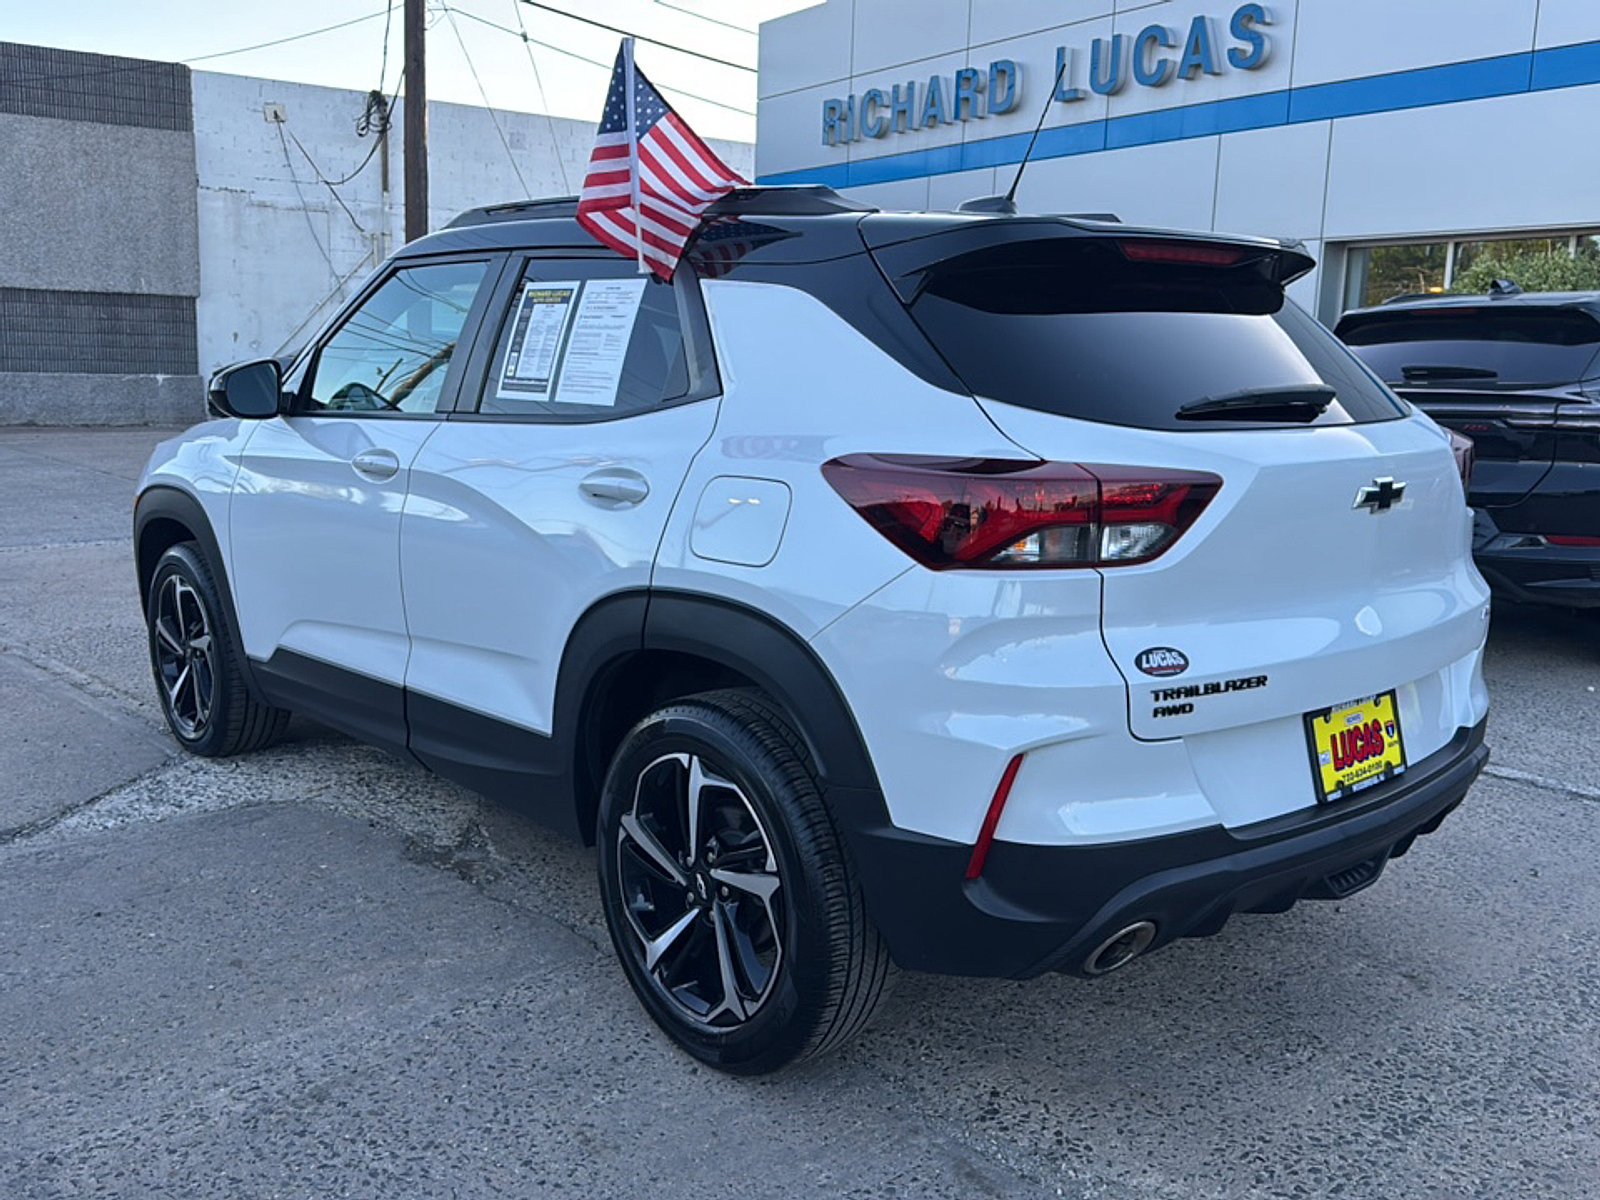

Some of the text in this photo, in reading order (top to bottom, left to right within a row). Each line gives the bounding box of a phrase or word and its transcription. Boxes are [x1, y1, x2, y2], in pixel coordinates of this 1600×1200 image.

[822, 2, 1274, 148] RICHARD LUCAS
[1141, 650, 1186, 670] LUCAS
[1151, 675, 1268, 702] TRAILBLAZER
[1152, 703, 1194, 719] AWD
[1330, 718, 1385, 773] LUCAS
